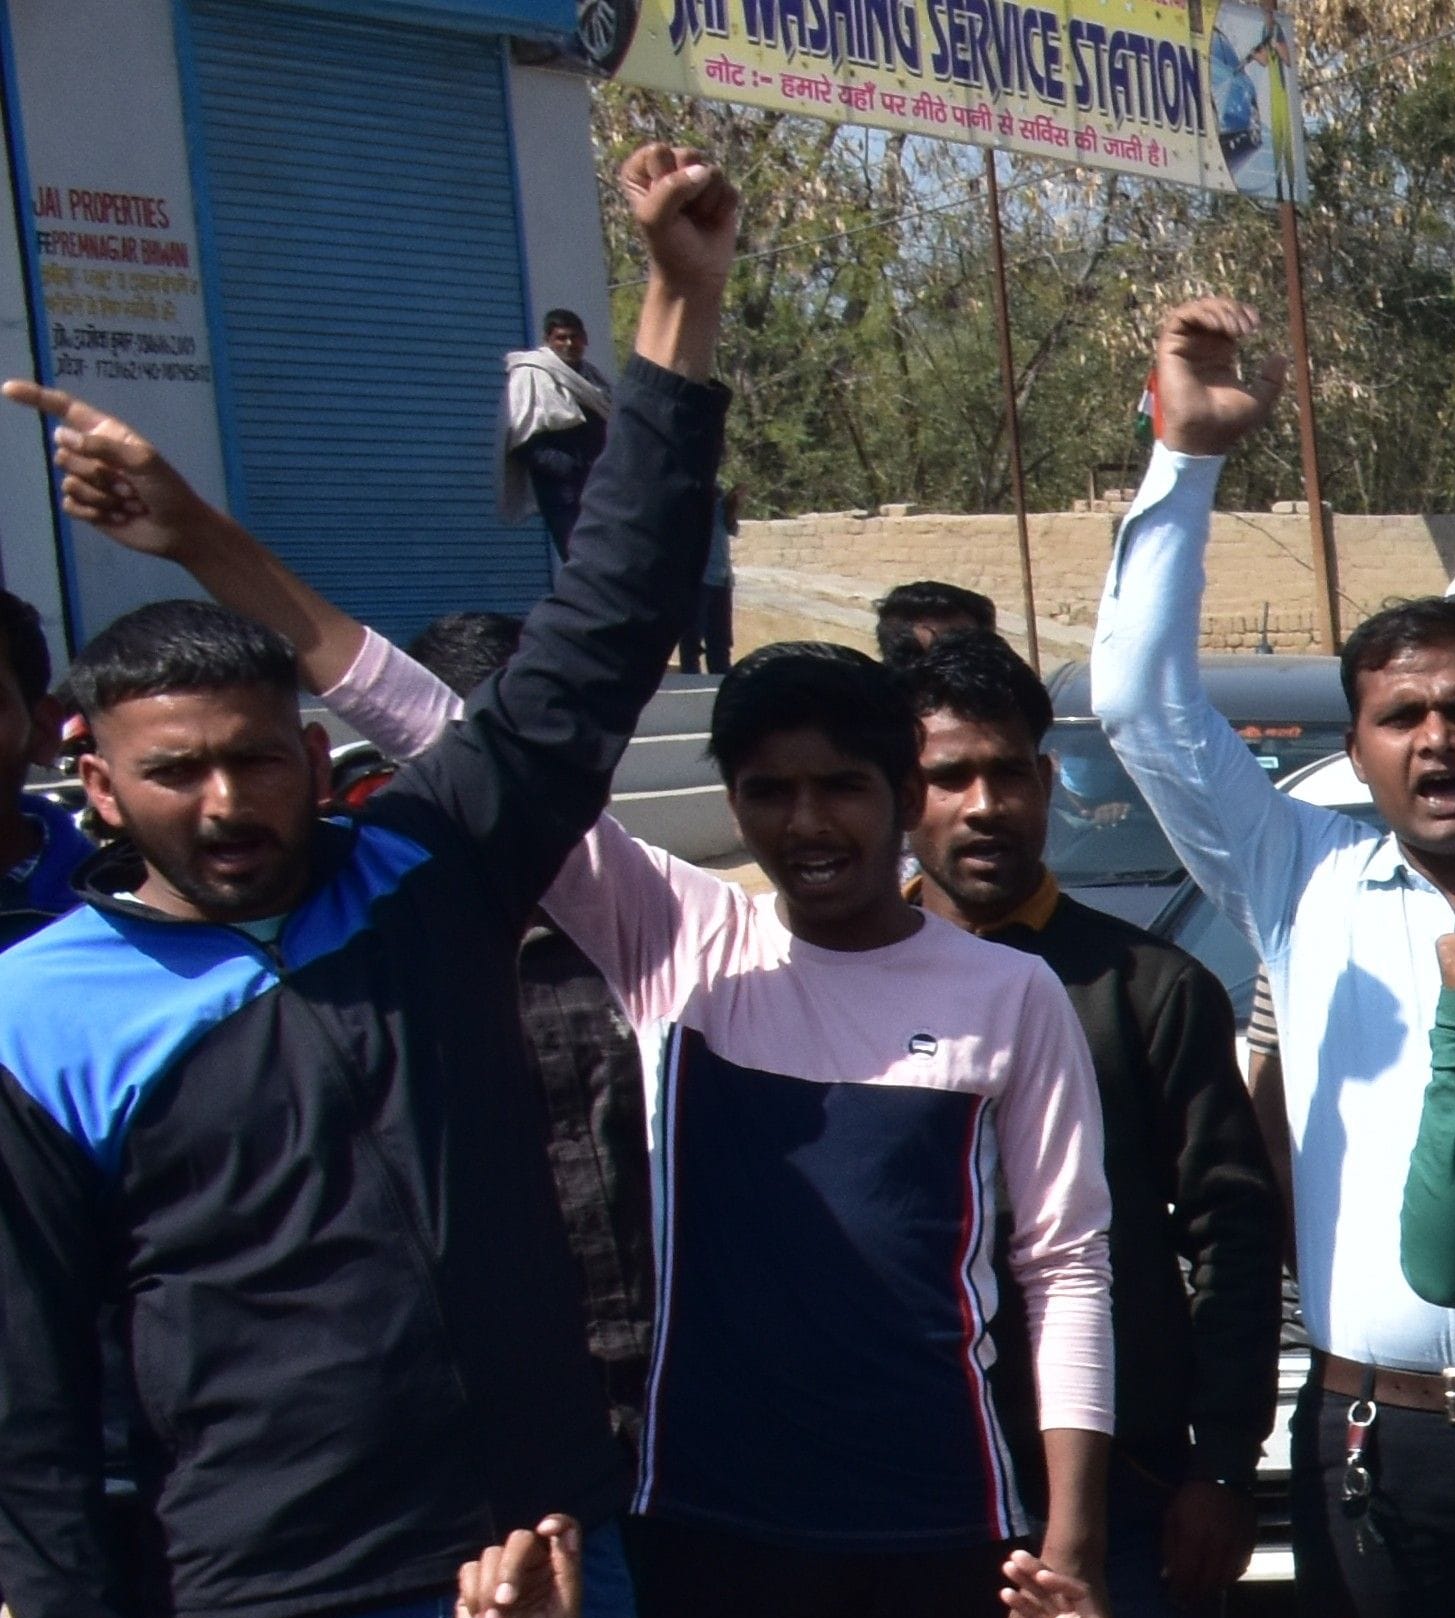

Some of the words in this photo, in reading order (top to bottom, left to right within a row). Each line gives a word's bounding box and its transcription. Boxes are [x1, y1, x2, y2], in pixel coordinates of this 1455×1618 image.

[704, 53, 746, 88] नोट
[779, 73, 834, 104] हमारे
[880, 92, 907, 117] पर
[910, 91, 949, 124] मीठे
[951, 102, 994, 132] पानी
[997, 108, 1015, 136] से
[1073, 124, 1099, 153] की
[1101, 133, 1144, 162] जाती
[926, 0, 1067, 105] SERVICE
[1068, 18, 1206, 136] STATION
[34, 186, 63, 220] JAI
[68, 188, 171, 230] PROPERTIES
